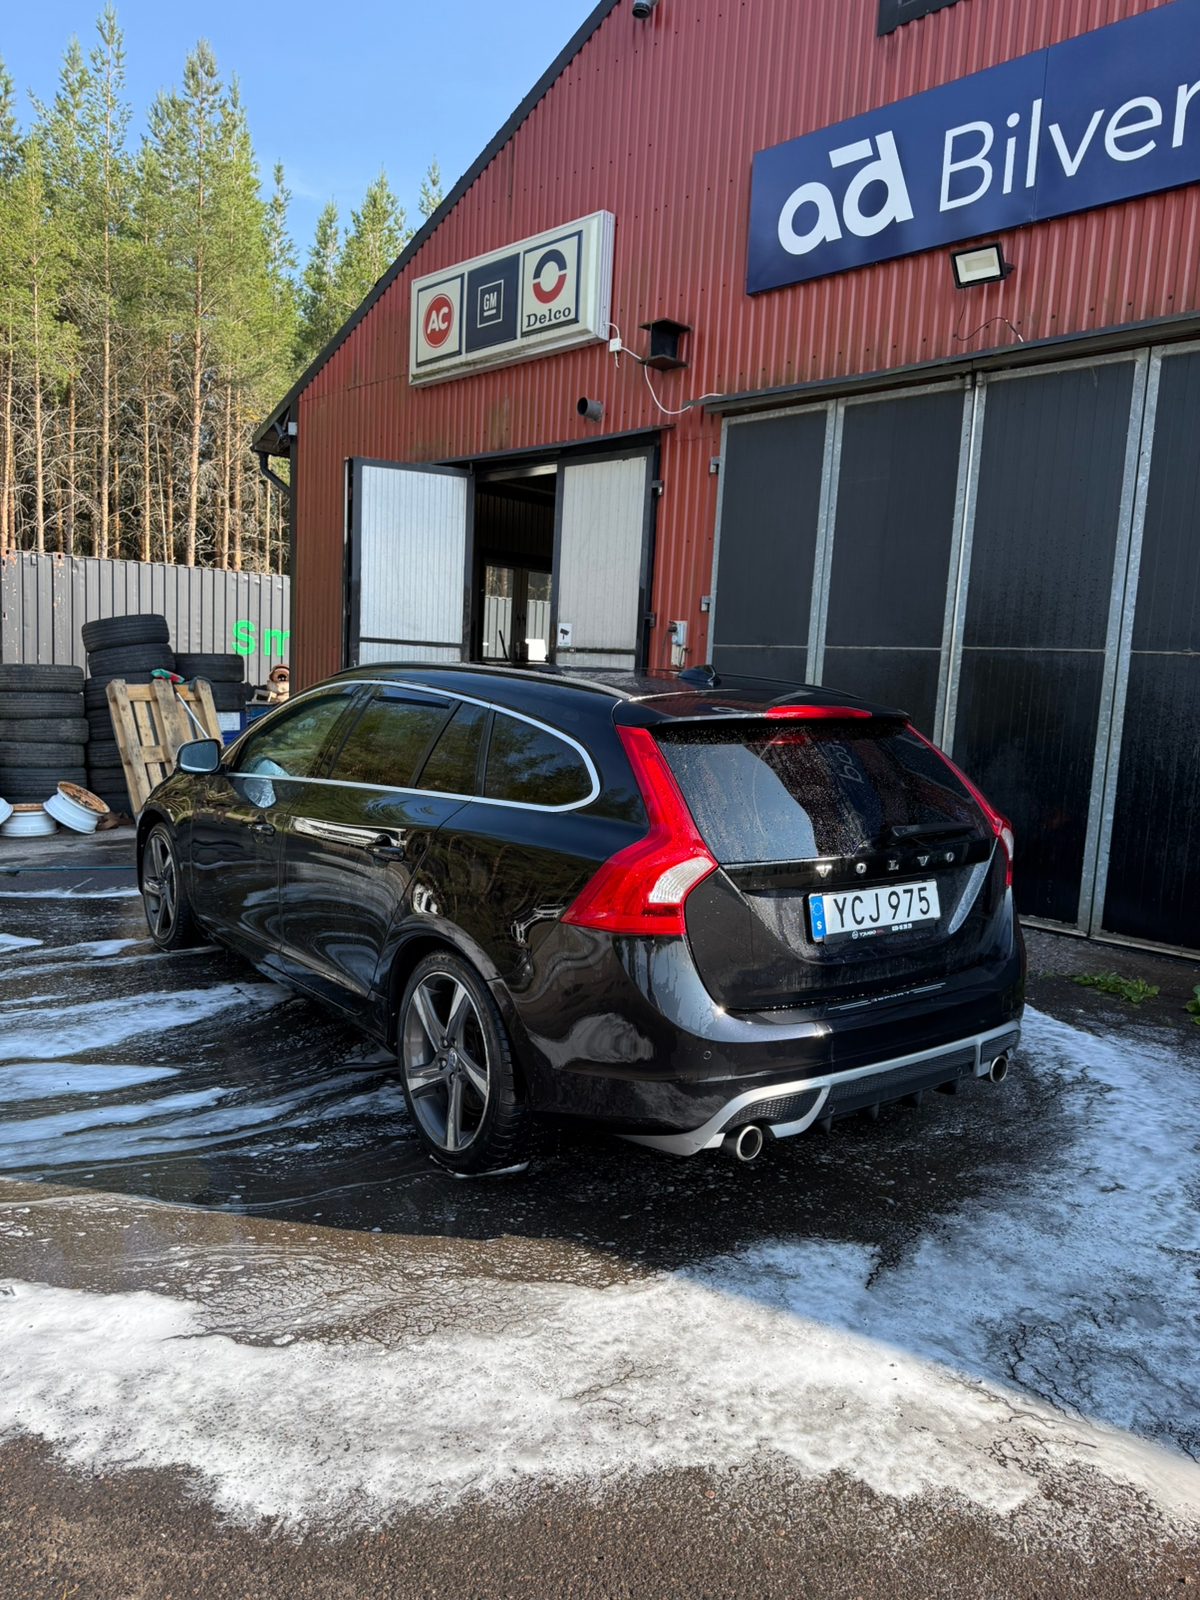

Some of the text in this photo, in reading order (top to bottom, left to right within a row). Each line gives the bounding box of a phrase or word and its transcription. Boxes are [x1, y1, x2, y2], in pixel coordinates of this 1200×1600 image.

[939, 80, 1200, 212] Bilver
[483, 291, 498, 310] GM
[427, 306, 449, 335] AC
[526, 306, 572, 328] Delco
[815, 852, 956, 878] VOLVO
[833, 886, 930, 928] YCJ 975
[816, 920, 823, 930] S
